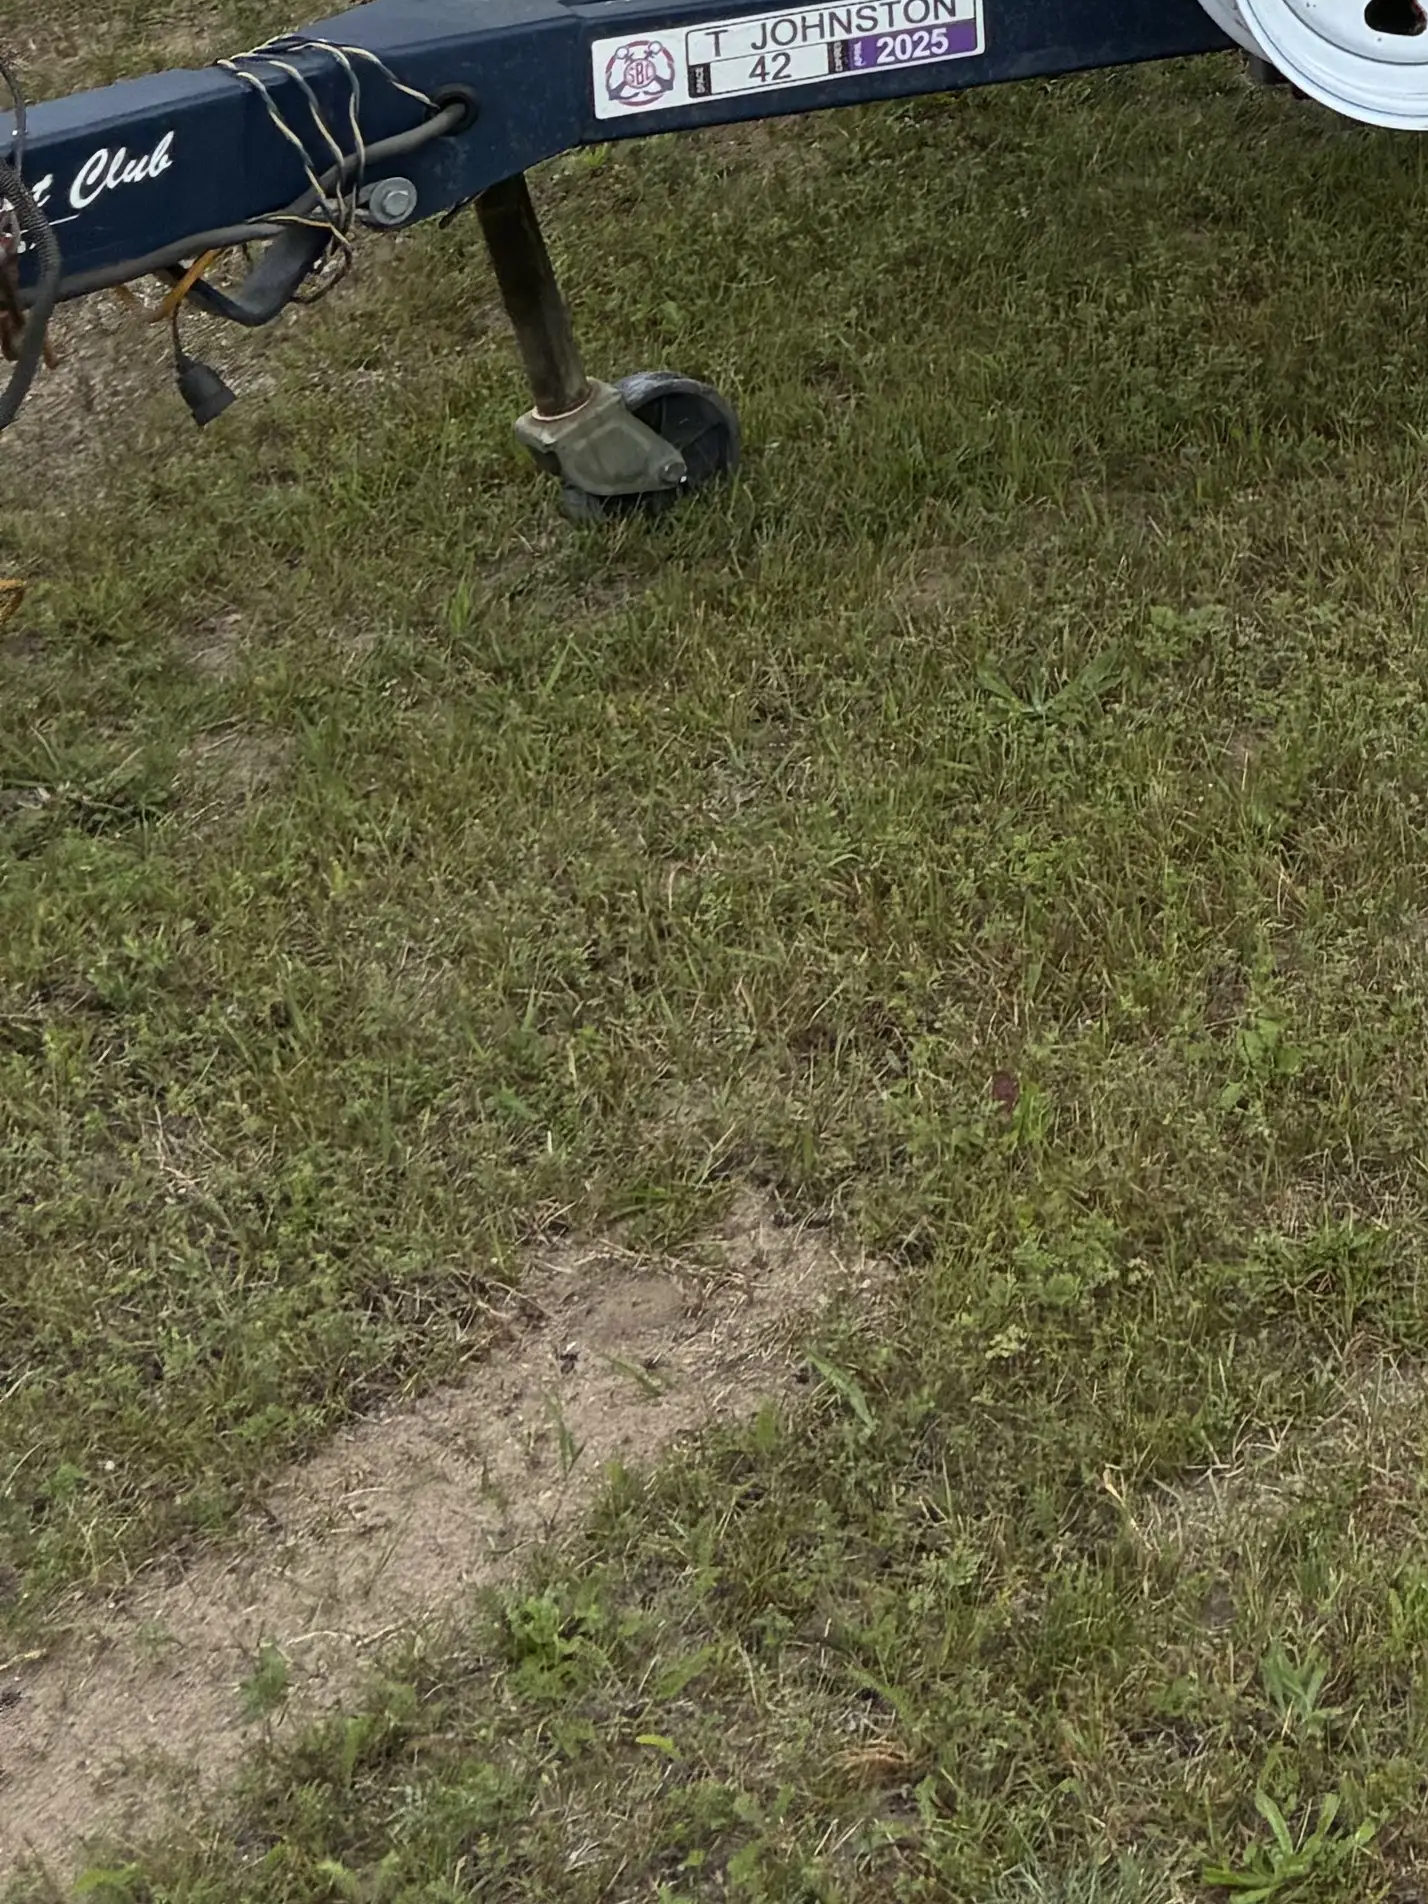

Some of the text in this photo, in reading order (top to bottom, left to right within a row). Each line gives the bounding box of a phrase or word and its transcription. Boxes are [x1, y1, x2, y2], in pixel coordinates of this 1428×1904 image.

[705, 29, 728, 57] T
[876, 28, 950, 64] 2025
[749, 52, 792, 82] 42
[69, 131, 175, 209] Club
